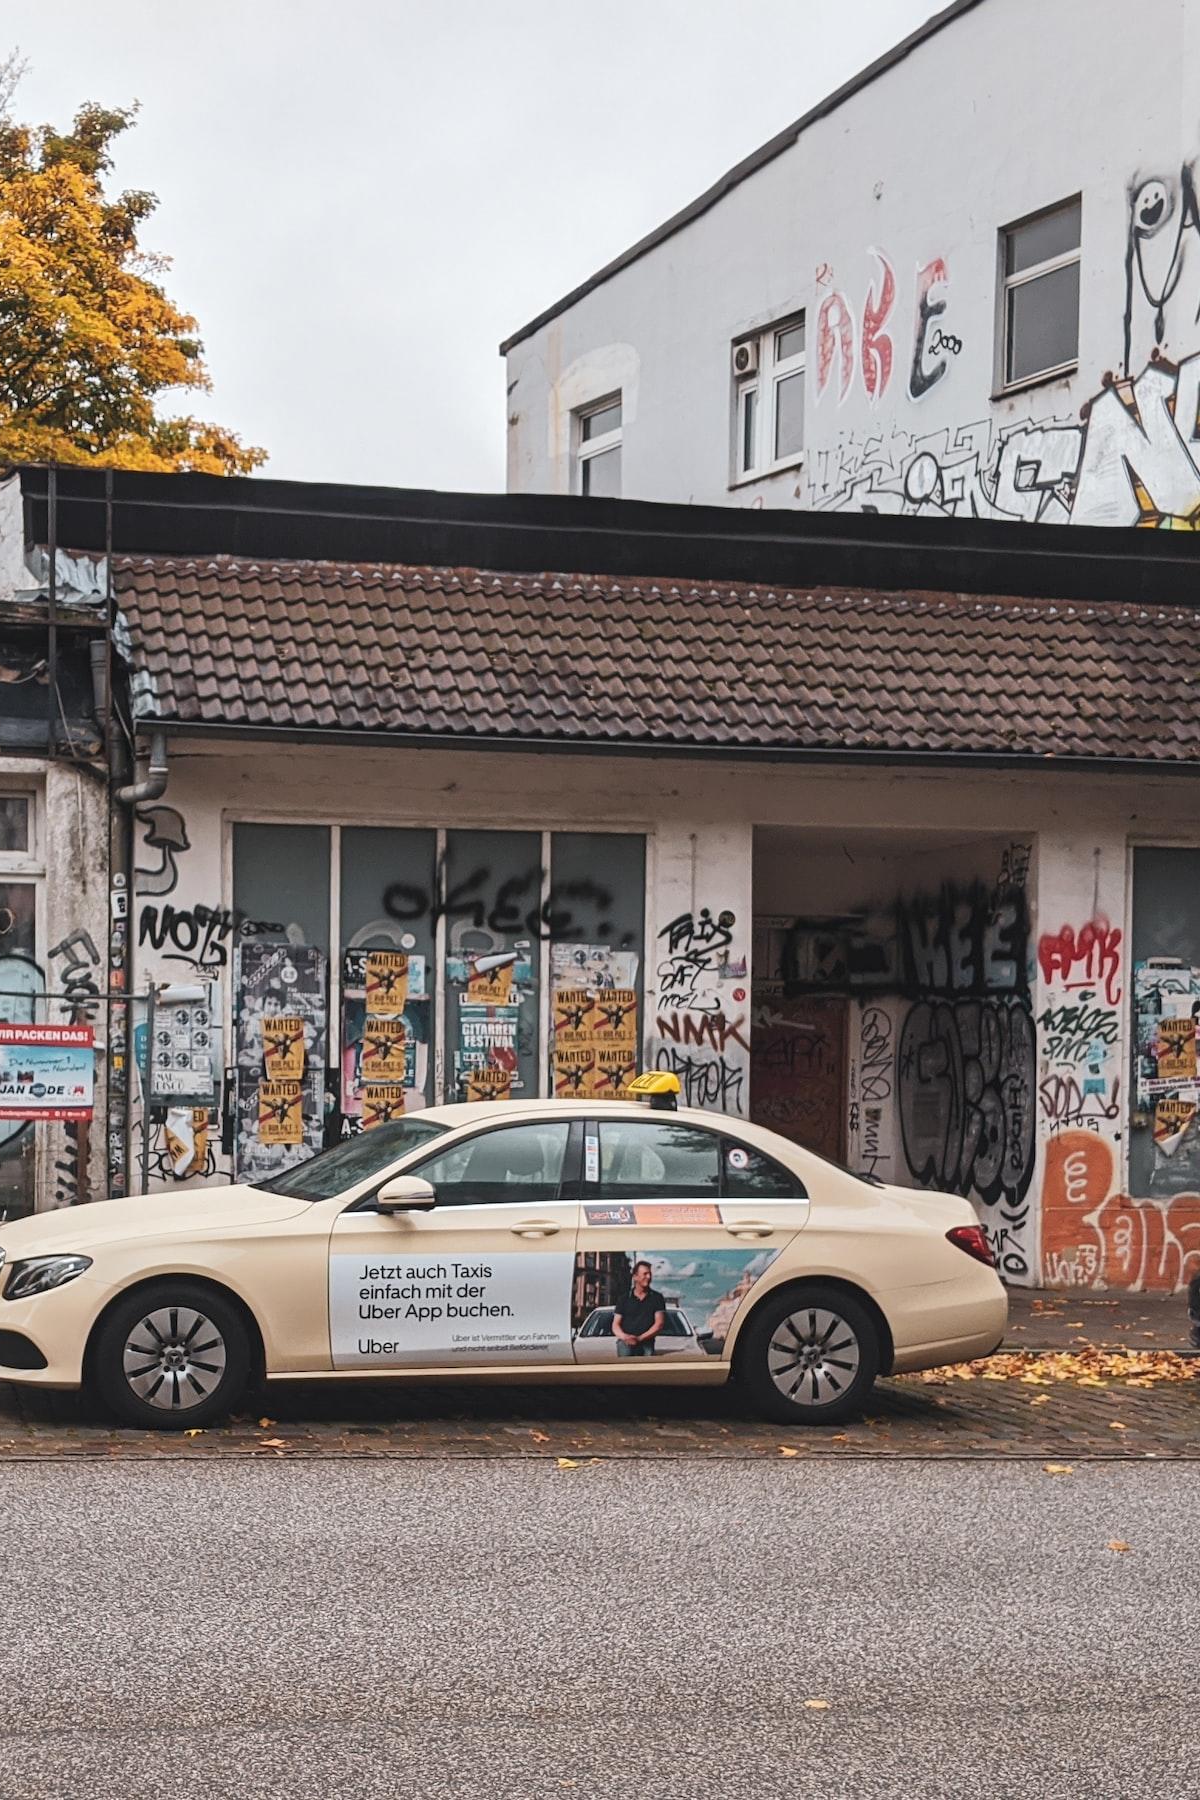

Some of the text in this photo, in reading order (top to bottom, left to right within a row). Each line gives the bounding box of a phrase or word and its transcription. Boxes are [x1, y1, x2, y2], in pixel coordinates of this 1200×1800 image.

[370, 954, 405, 967] WANTED
[557, 991, 588, 1004] WANTE
[600, 991, 633, 1003] WANTED
[264, 1020, 300, 1032] WANTED
[367, 1021, 402, 1034] WANTED
[1160, 1020, 1192, 1033] WANTED
[15, 1030, 61, 1041] PACKEN
[61, 1031, 88, 1042] DAS!
[557, 1051, 591, 1063] WANTED
[599, 1051, 633, 1063] WANTED
[0, 1085, 26, 1095] JAN
[262, 1084, 299, 1096] WANTED
[367, 1086, 402, 1099] WANTED
[359, 1263, 492, 1280] Jetzt auch Taxis
[359, 1283, 486, 1300] einfach mit der
[359, 1303, 515, 1322] Uber App buchen.
[358, 1339, 400, 1354] Uber
